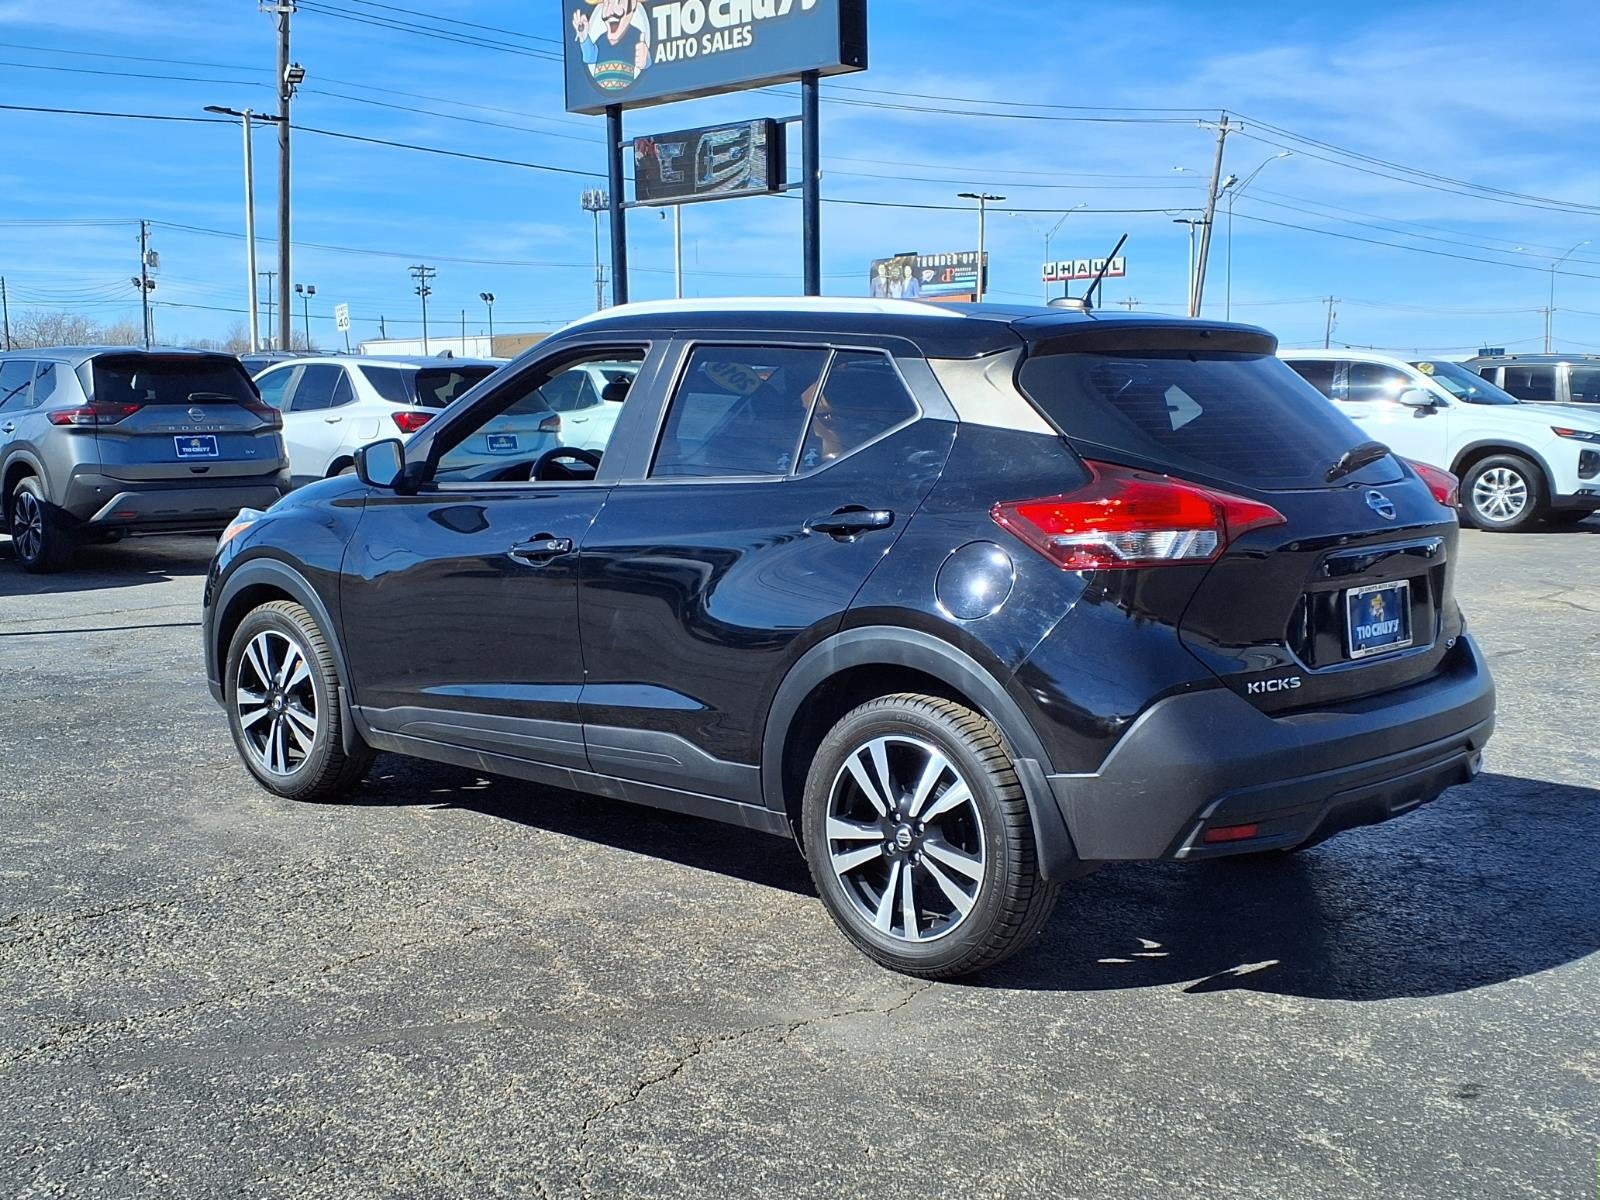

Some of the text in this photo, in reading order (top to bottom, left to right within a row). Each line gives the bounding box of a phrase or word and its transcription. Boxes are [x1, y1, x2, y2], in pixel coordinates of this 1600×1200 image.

[652, 0, 706, 40] TIO
[655, 25, 752, 63] AUTO SALES
[917, 255, 957, 267] THUNDER
[338, 316, 348, 328] 40
[1357, 624, 1371, 640] TIO
[1247, 676, 1301, 694] KICKS
